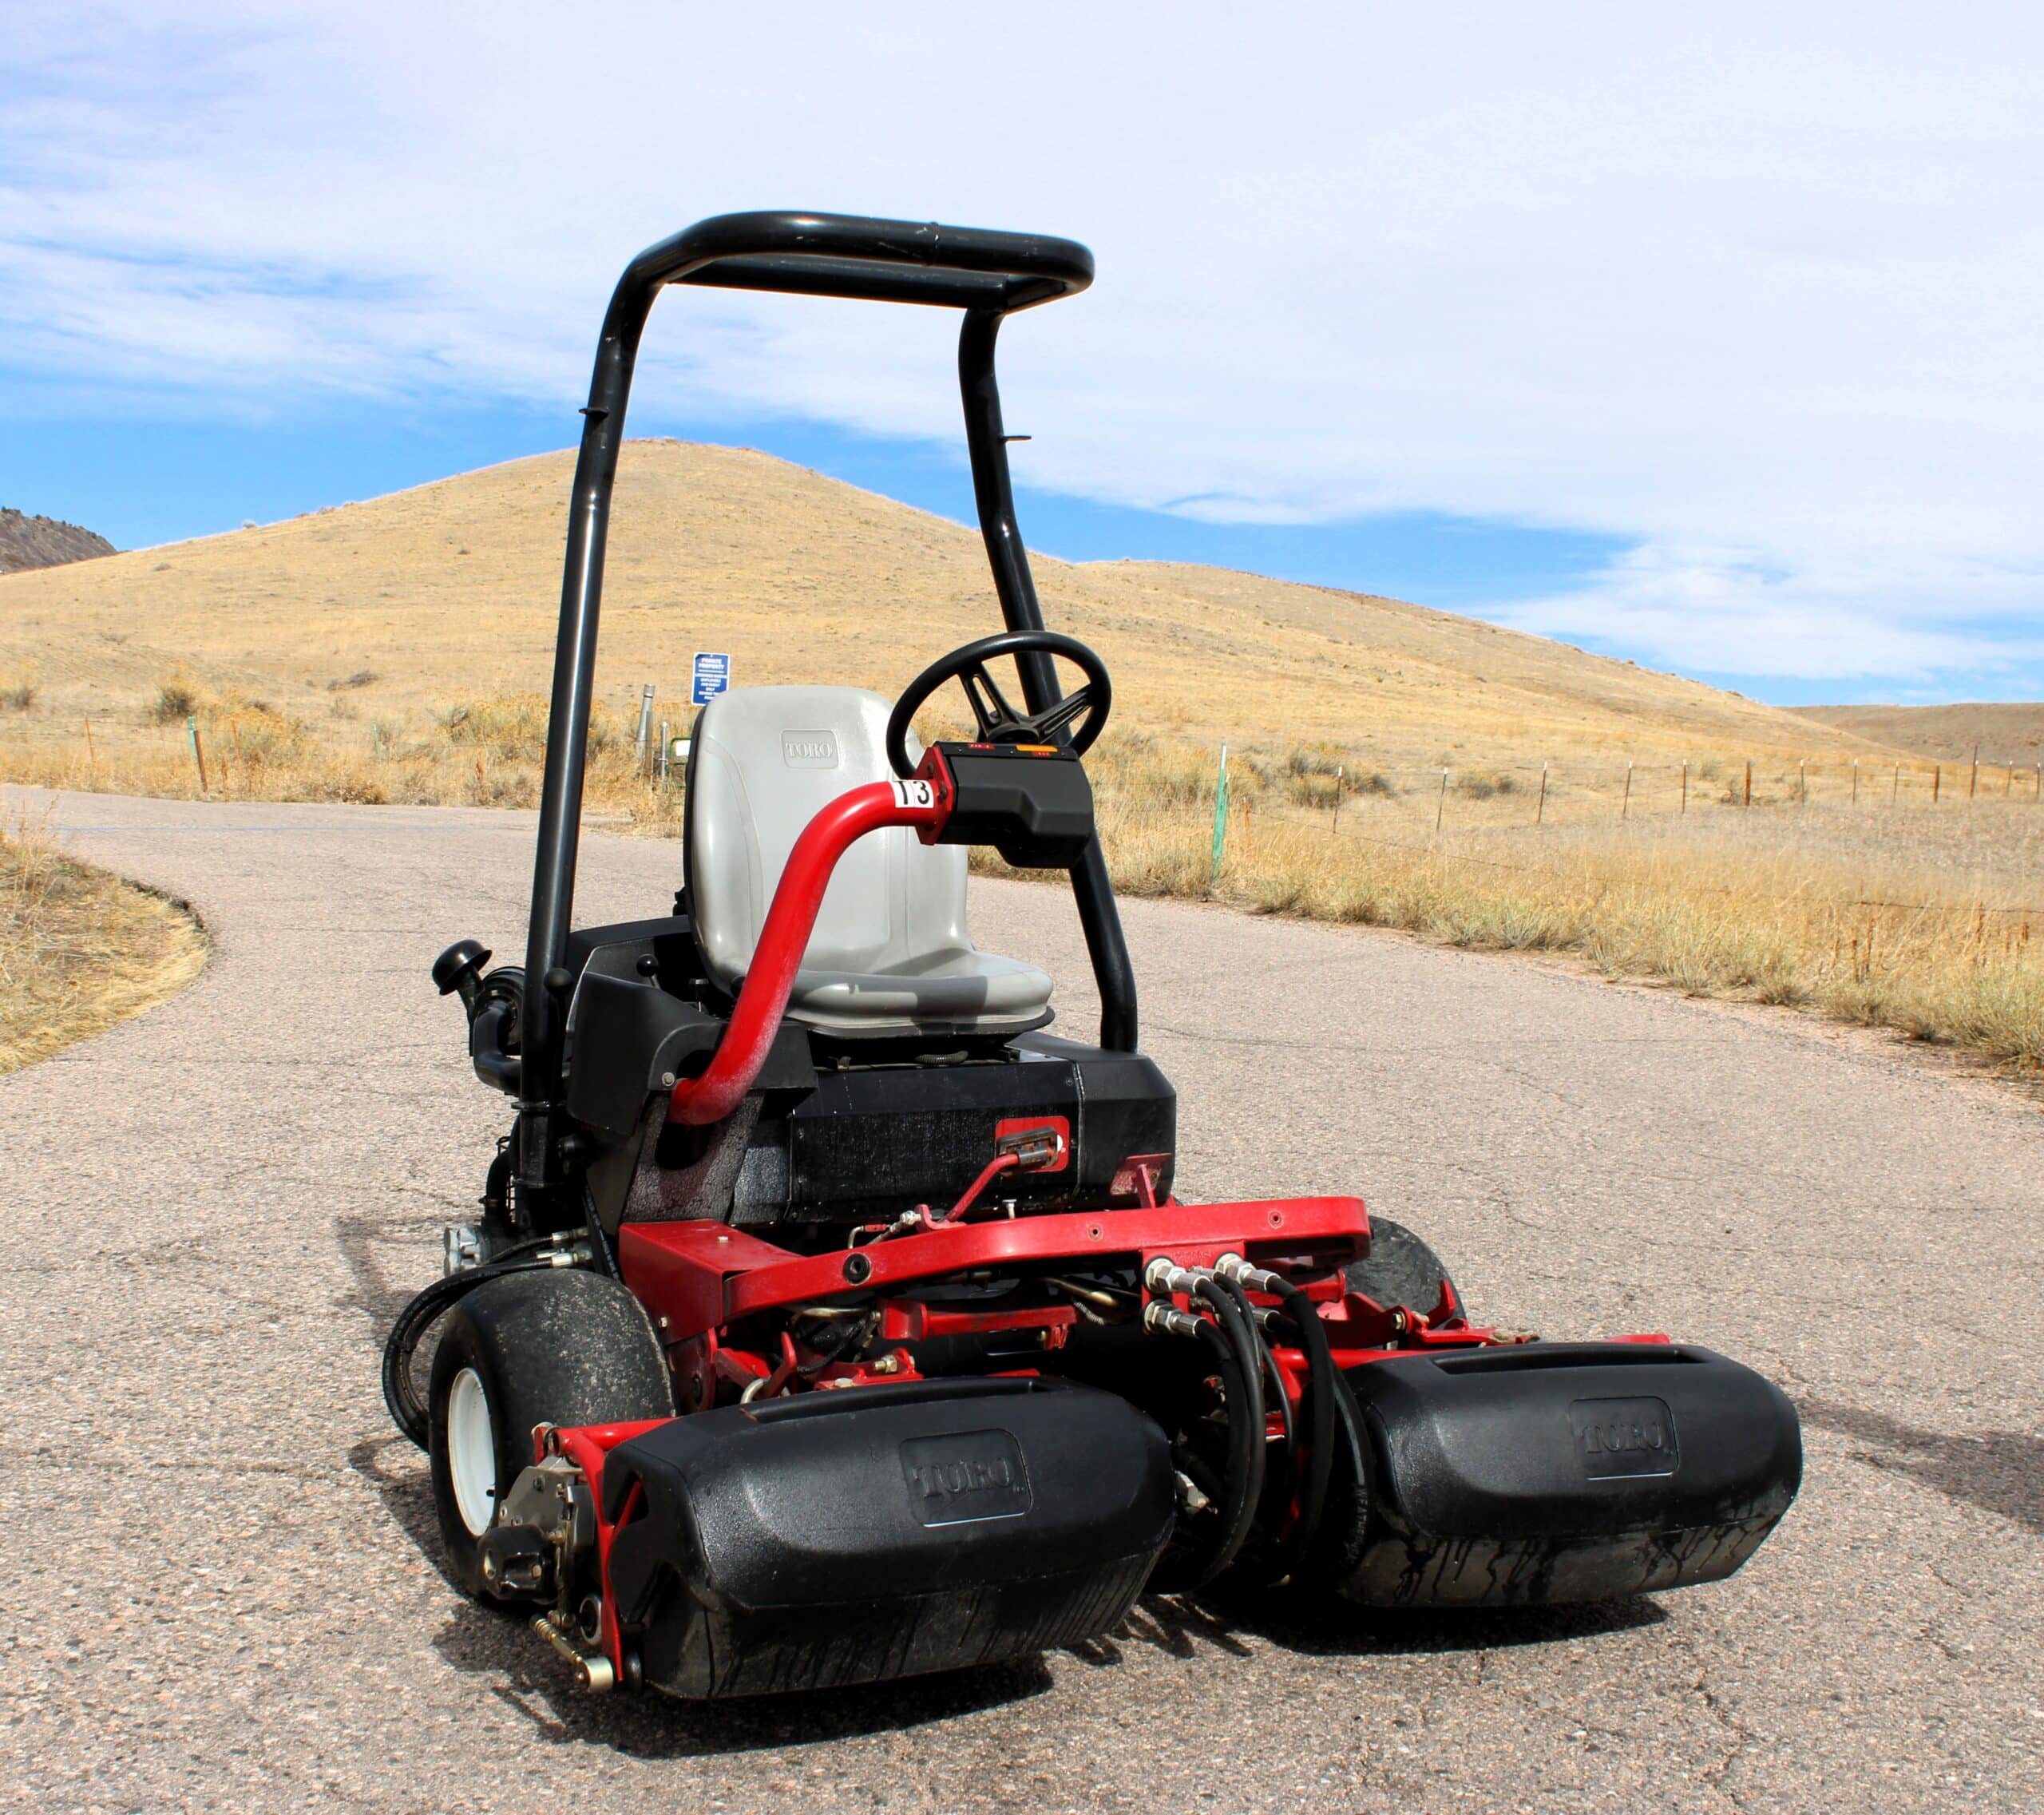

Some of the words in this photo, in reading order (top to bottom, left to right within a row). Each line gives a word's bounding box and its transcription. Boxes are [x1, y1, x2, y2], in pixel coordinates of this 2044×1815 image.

[785, 742, 833, 759] TORO
[1580, 1422, 1663, 1454] TORO
[913, 1456, 1015, 1498] TORO
